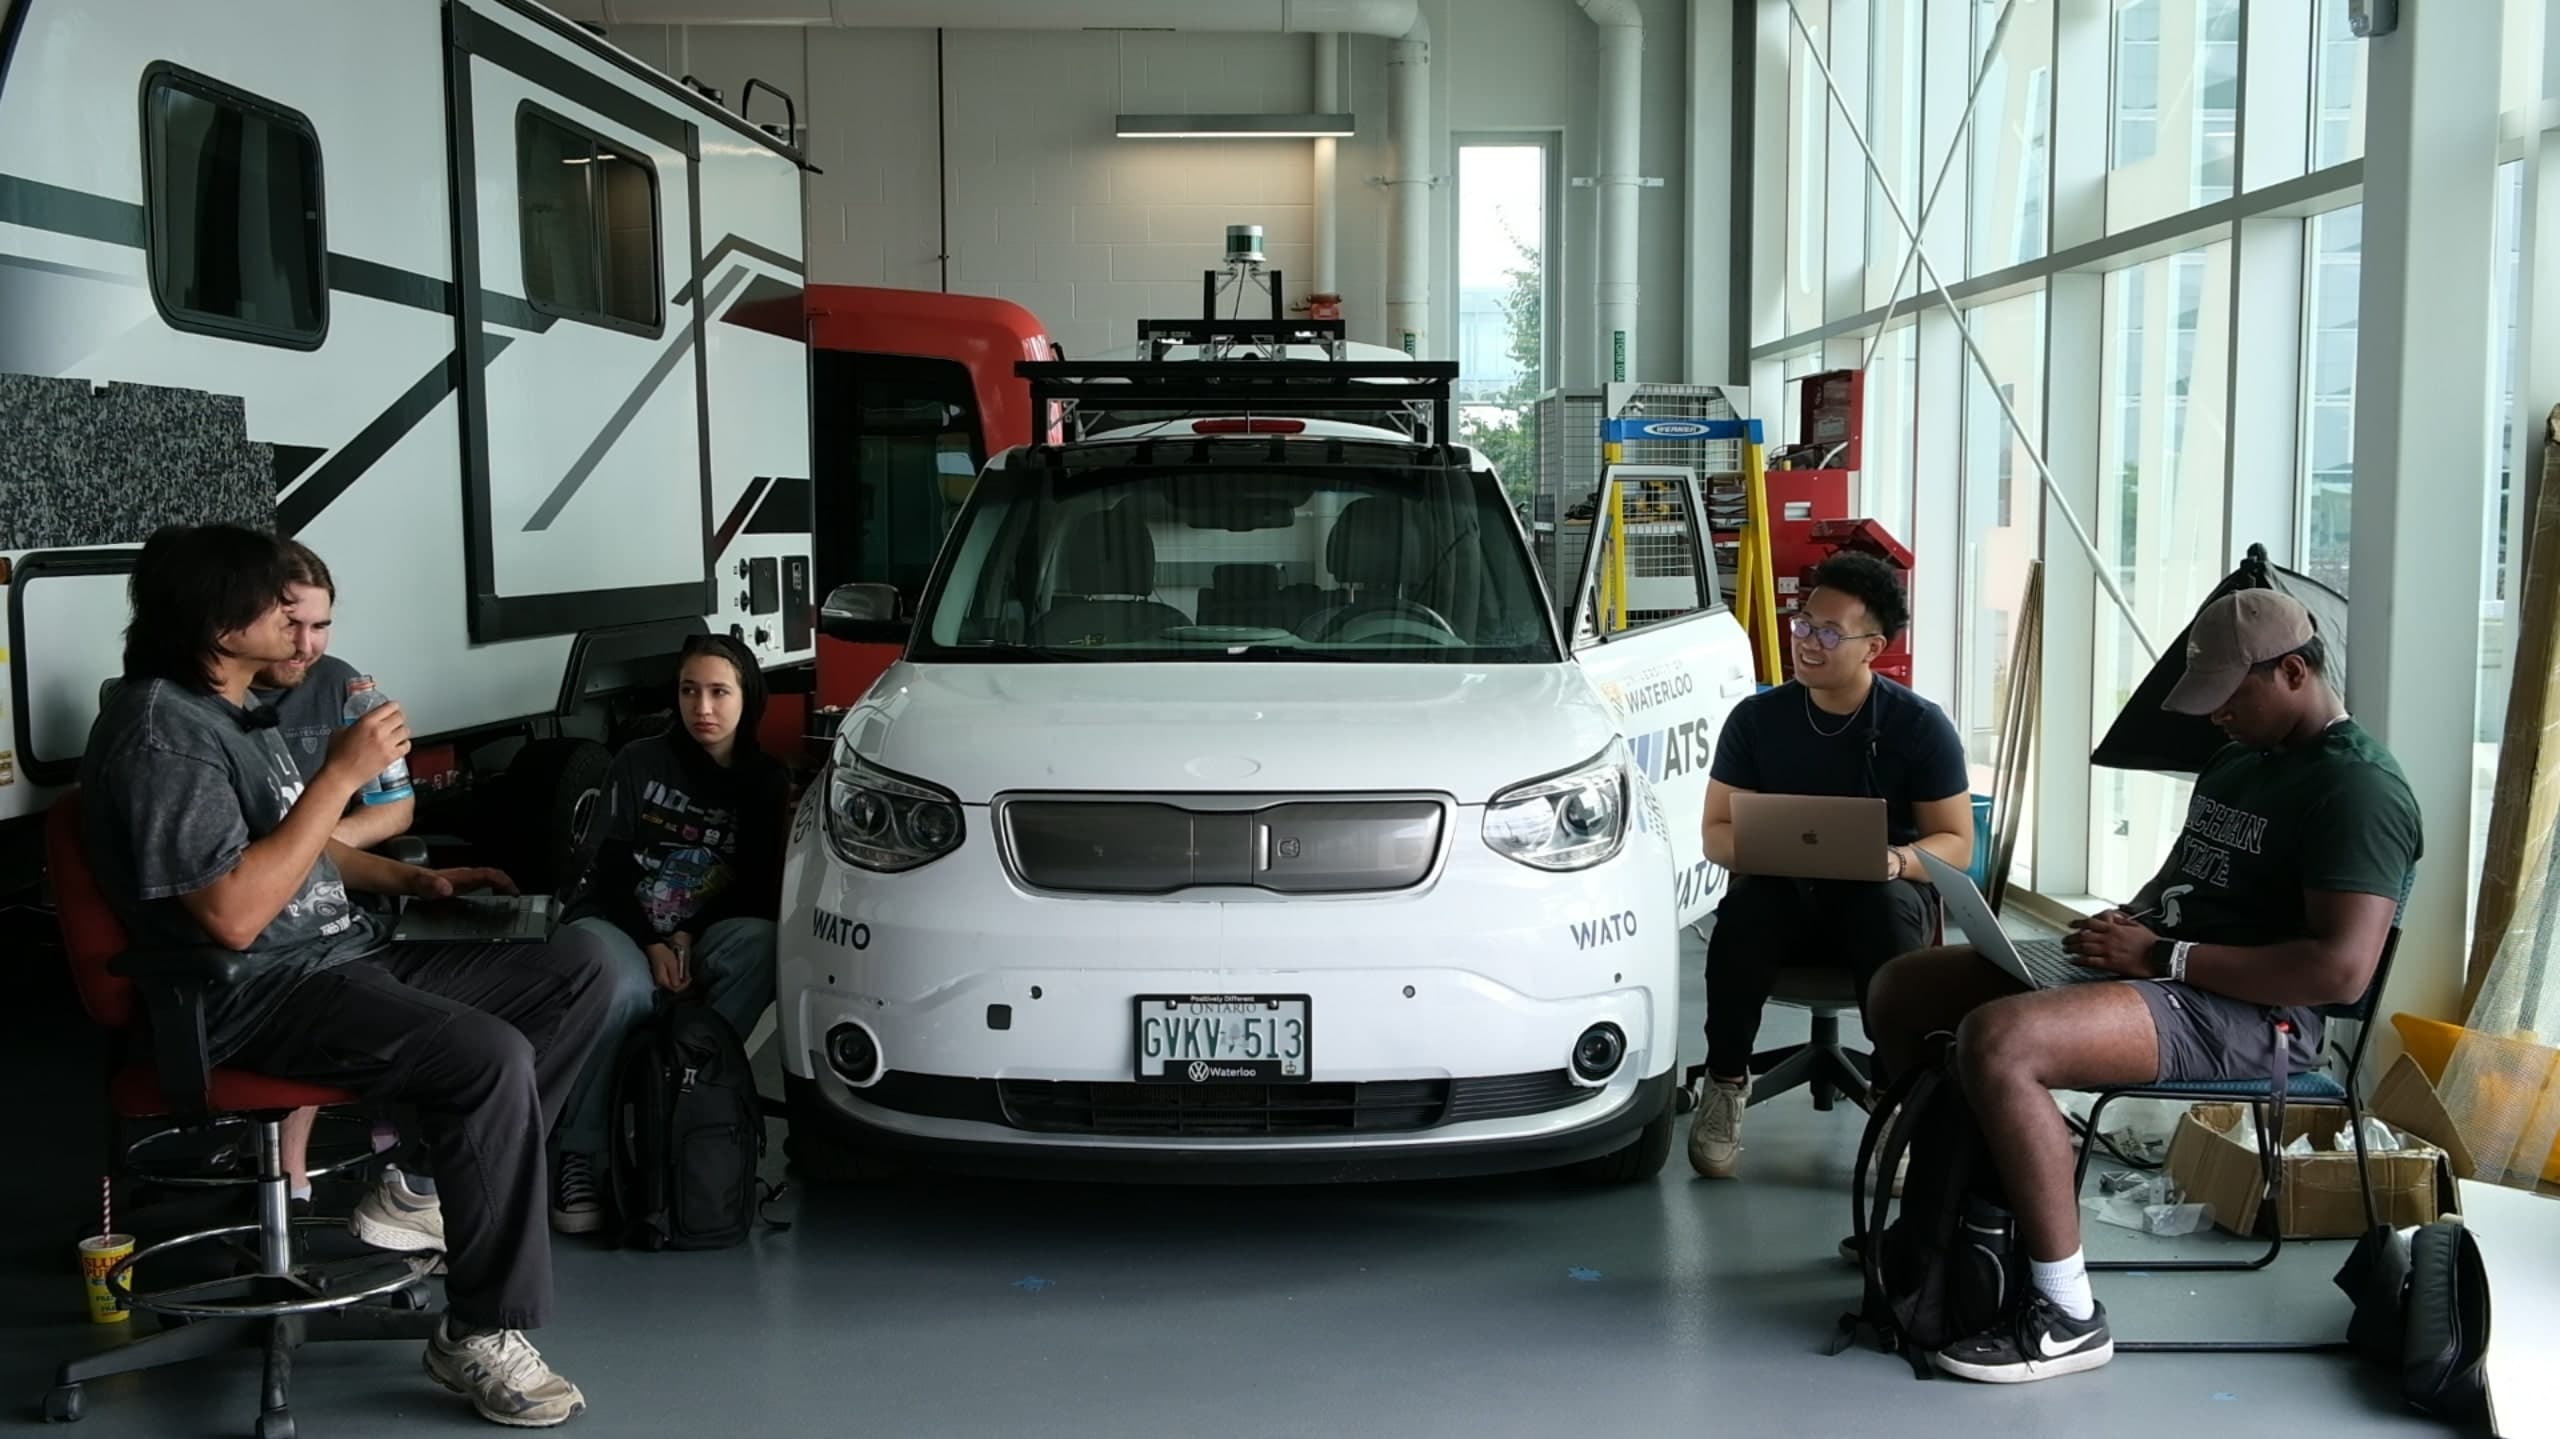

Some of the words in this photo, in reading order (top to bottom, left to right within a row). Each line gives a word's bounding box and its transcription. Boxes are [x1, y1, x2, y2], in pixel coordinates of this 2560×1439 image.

[1615, 332, 1625, 362] STORM
[1615, 363, 1625, 382] DRA
[1656, 425, 1697, 434] WERNER
[1625, 673, 1692, 713] WATERLOO
[812, 907, 871, 951] WATO
[1569, 910, 1637, 951] WATO
[1190, 995, 1223, 1003] Positively
[1190, 1003, 1257, 1016] ONTARIO
[1144, 1017, 1221, 1059] GVKV
[1244, 1017, 1303, 1059] 513
[1210, 1067, 1257, 1078] Waterloo
